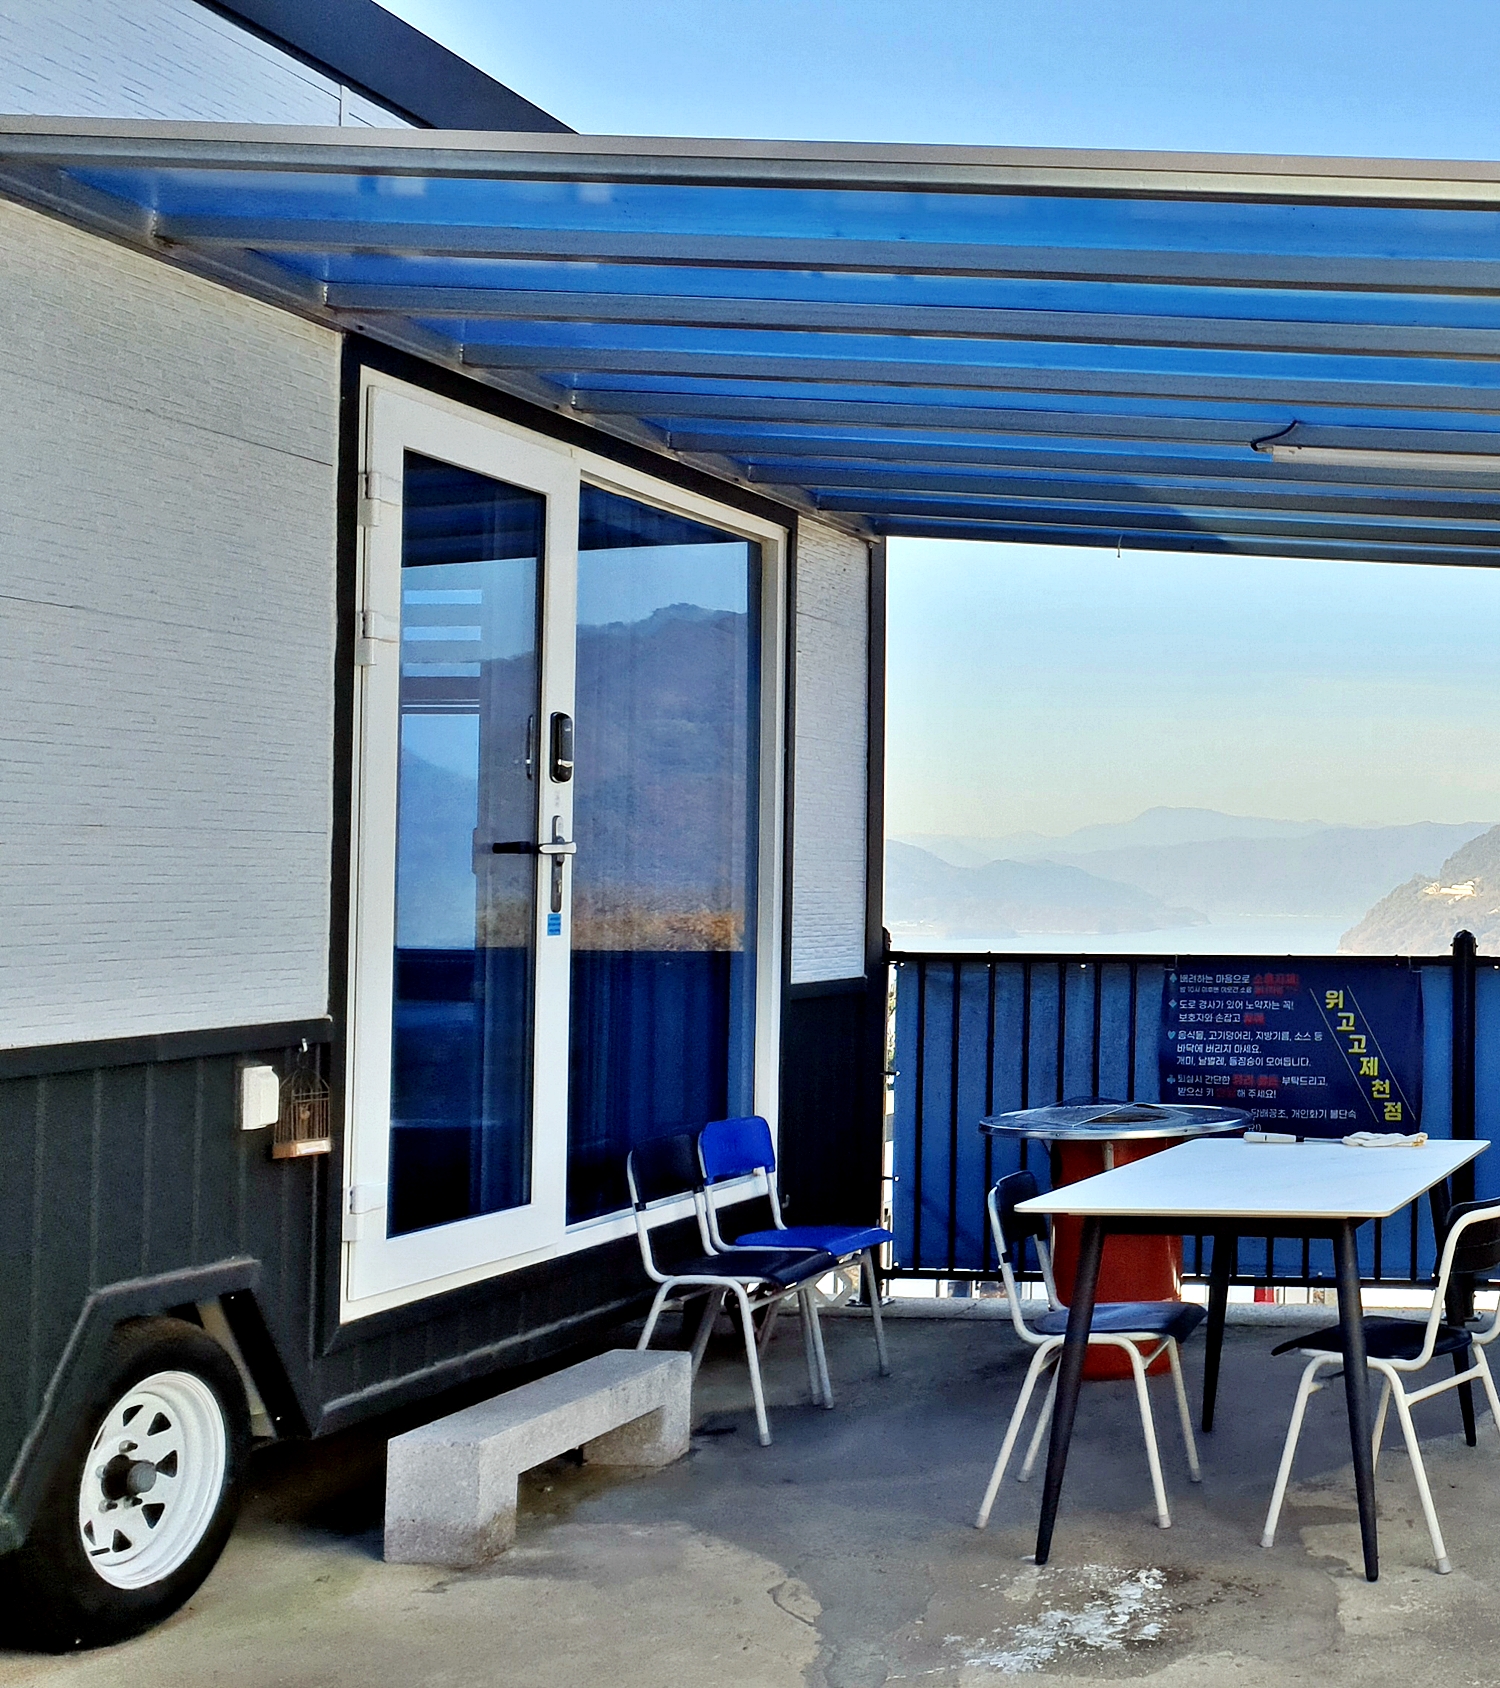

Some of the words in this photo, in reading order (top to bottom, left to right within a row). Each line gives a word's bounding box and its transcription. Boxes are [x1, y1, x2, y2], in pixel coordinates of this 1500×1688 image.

[1216, 974, 1250, 983] 마음으로
[1179, 1000, 1196, 1009] 도로
[1199, 1000, 1224, 1009] 경사가
[1226, 1000, 1243, 1009] 있어
[1246, 1000, 1280, 1010] 노약자는
[1179, 1013, 1213, 1022] 보호자와
[1215, 1013, 1241, 1022] 손잡고
[1178, 1031, 1206, 1041] 음식물,
[1256, 1031, 1291, 1041] 지방기름,
[1294, 1032, 1311, 1041] 소스
[1314, 1032, 1323, 1041] 등
[1177, 1044, 1203, 1052] 바닥에
[1206, 1044, 1231, 1053] 버리지
[1234, 1045, 1262, 1053] 마세요.
[1199, 1057, 1226, 1066] 날벌레,
[1177, 1075, 1202, 1083] 퇴실시
[1205, 1075, 1230, 1084] 간단한
[1282, 1076, 1328, 1086] 부탁드리고,
[1177, 1088, 1203, 1096] 받으신
[1206, 1088, 1214, 1096] 키
[1249, 1089, 1276, 1098] 주세요!
[1292, 1109, 1327, 1119] 개인화기
[1330, 1109, 1356, 1119] 불단속
